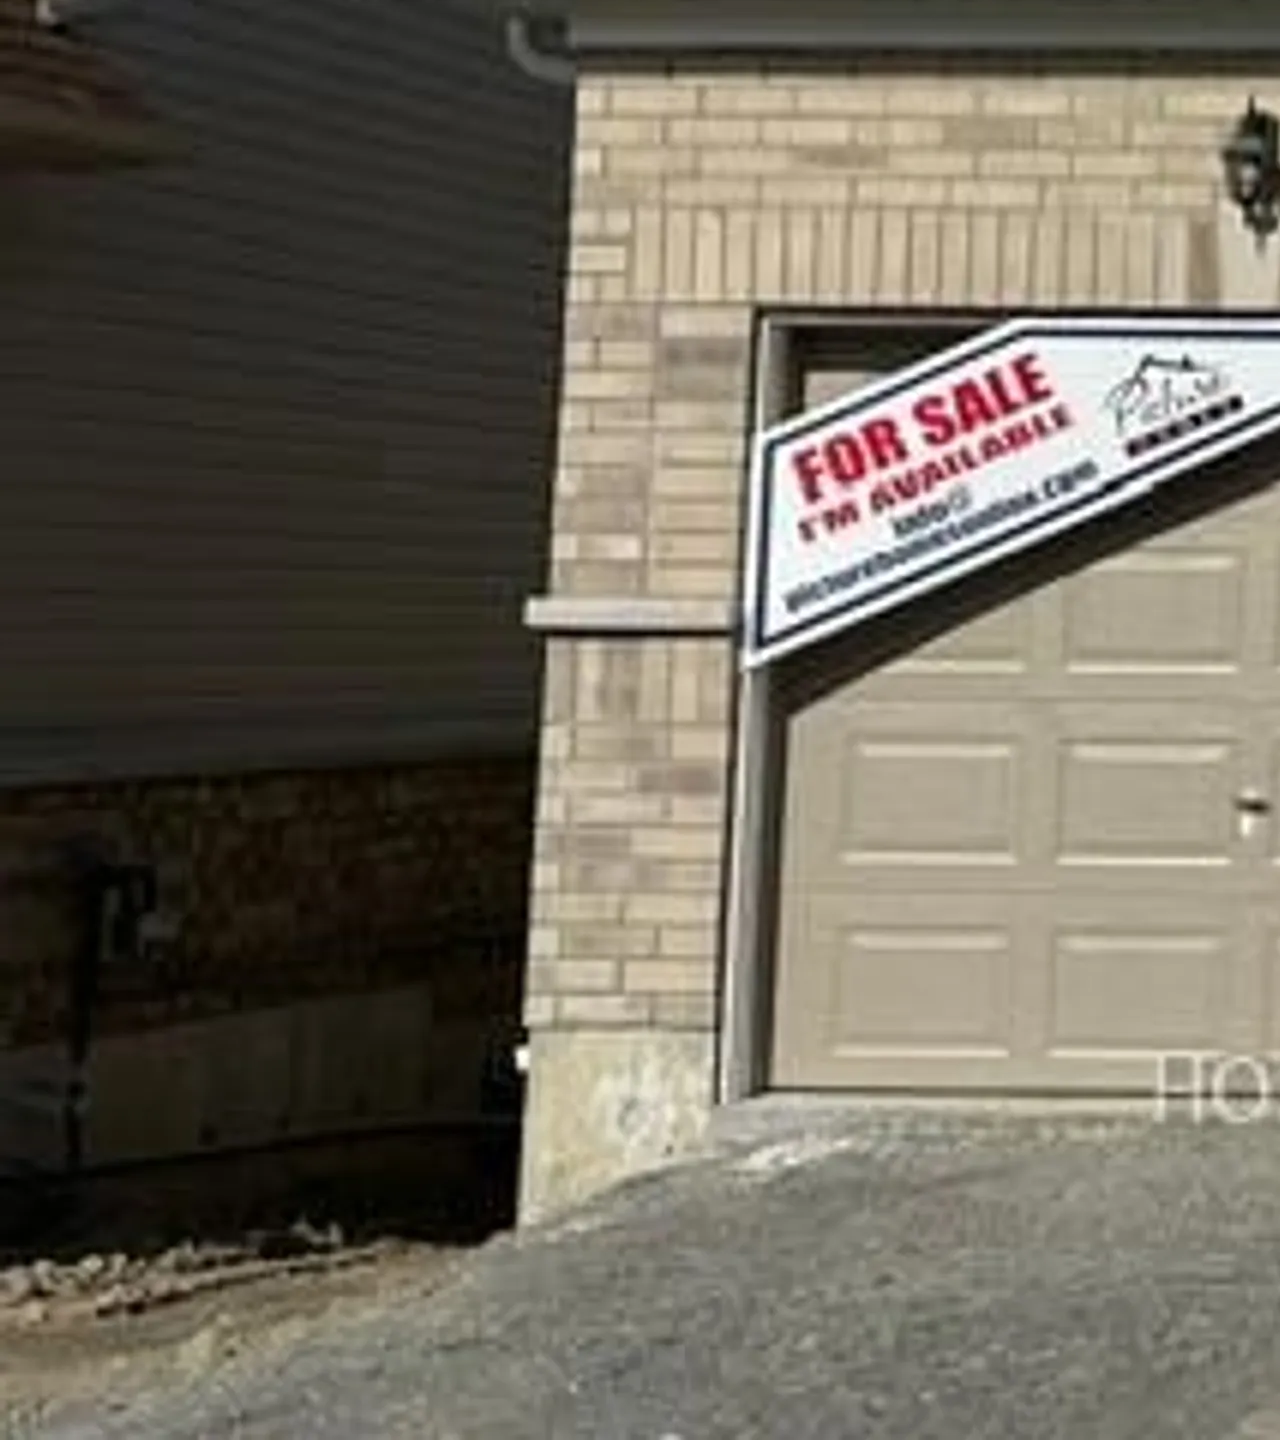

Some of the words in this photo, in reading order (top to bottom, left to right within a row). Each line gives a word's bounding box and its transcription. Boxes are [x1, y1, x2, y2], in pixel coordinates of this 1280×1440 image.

[791, 417, 909, 503] FOR
[911, 352, 1054, 446] SALE
[798, 501, 860, 542] I'M
[869, 403, 1075, 513] AVAILABLE
